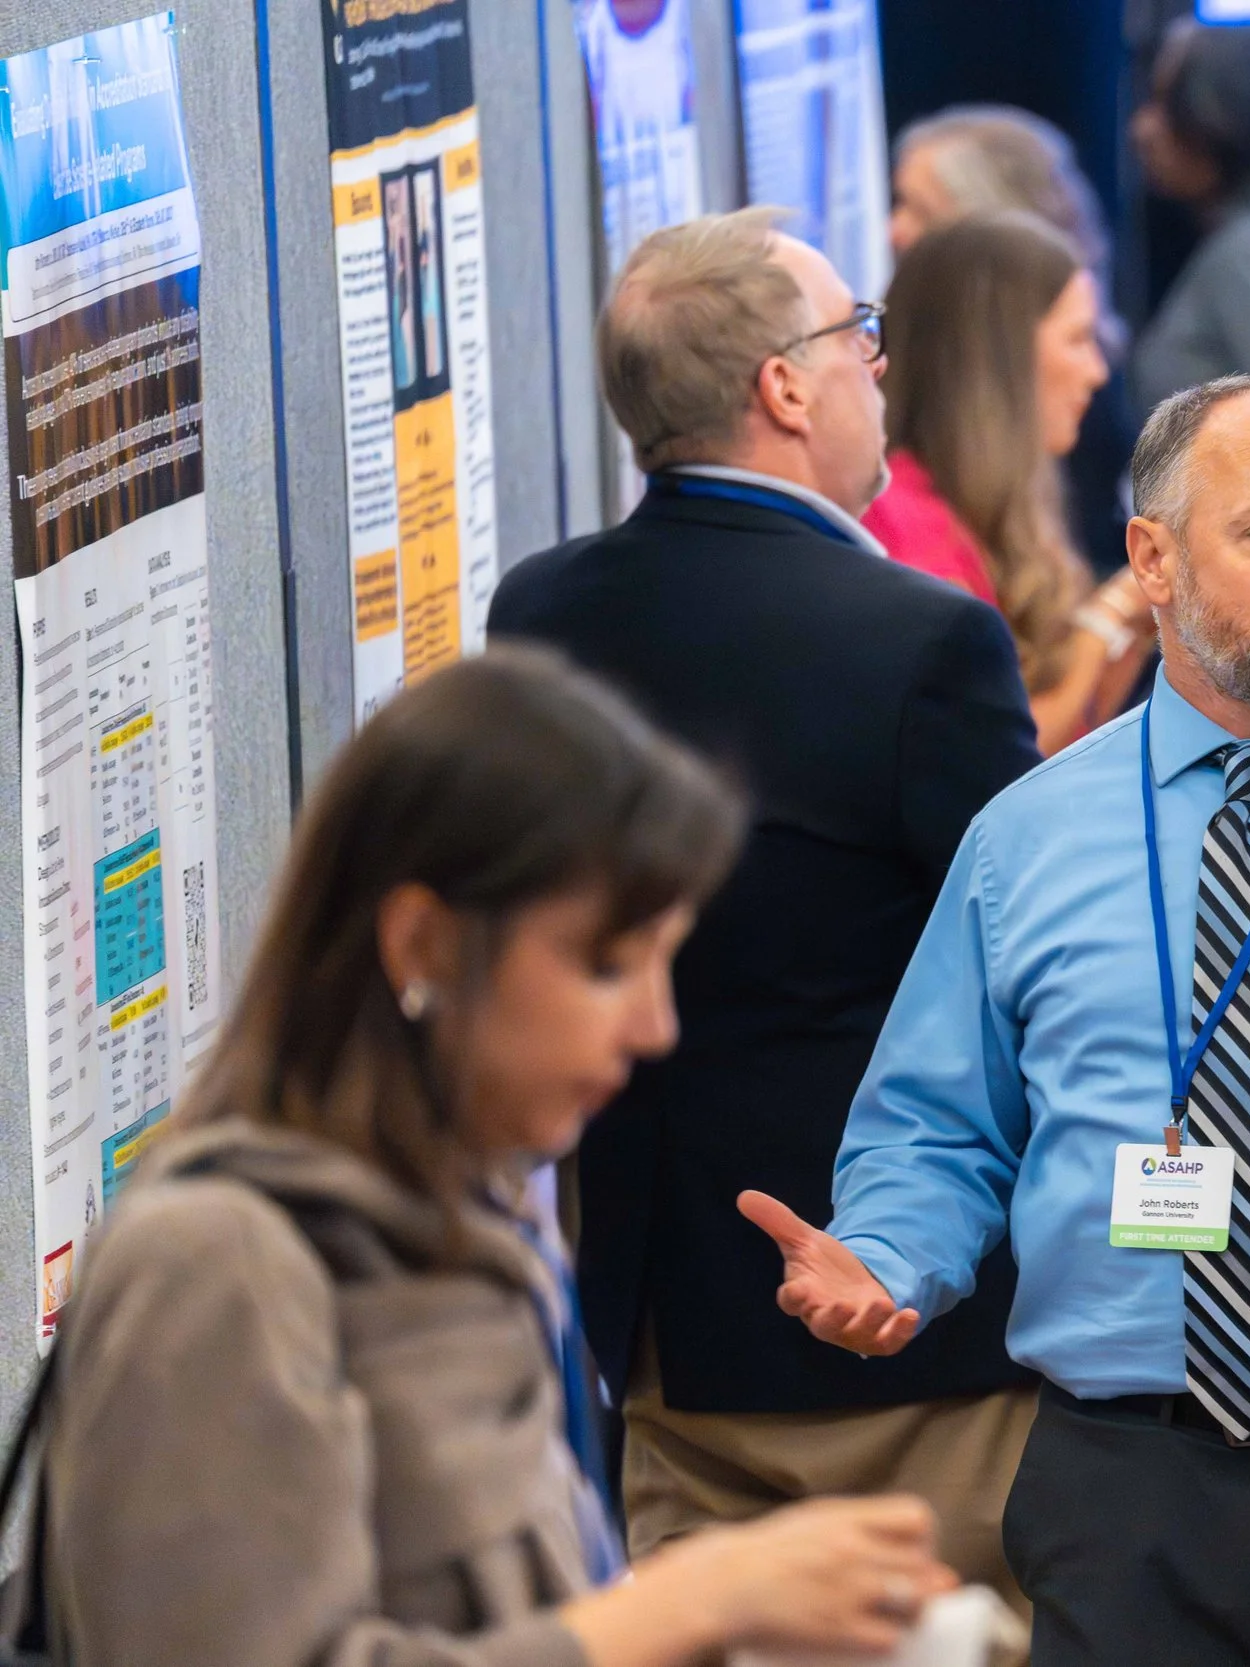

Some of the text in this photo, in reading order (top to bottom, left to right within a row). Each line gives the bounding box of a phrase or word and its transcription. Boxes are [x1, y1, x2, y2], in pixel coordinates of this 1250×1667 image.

[1157, 1161, 1204, 1175] ASAHP
[1139, 1199, 1199, 1210] John Roberts
[1165, 1211, 1195, 1219] University
[1119, 1232, 1143, 1241] FIRST
[1167, 1234, 1215, 1244] ATTENDEE
